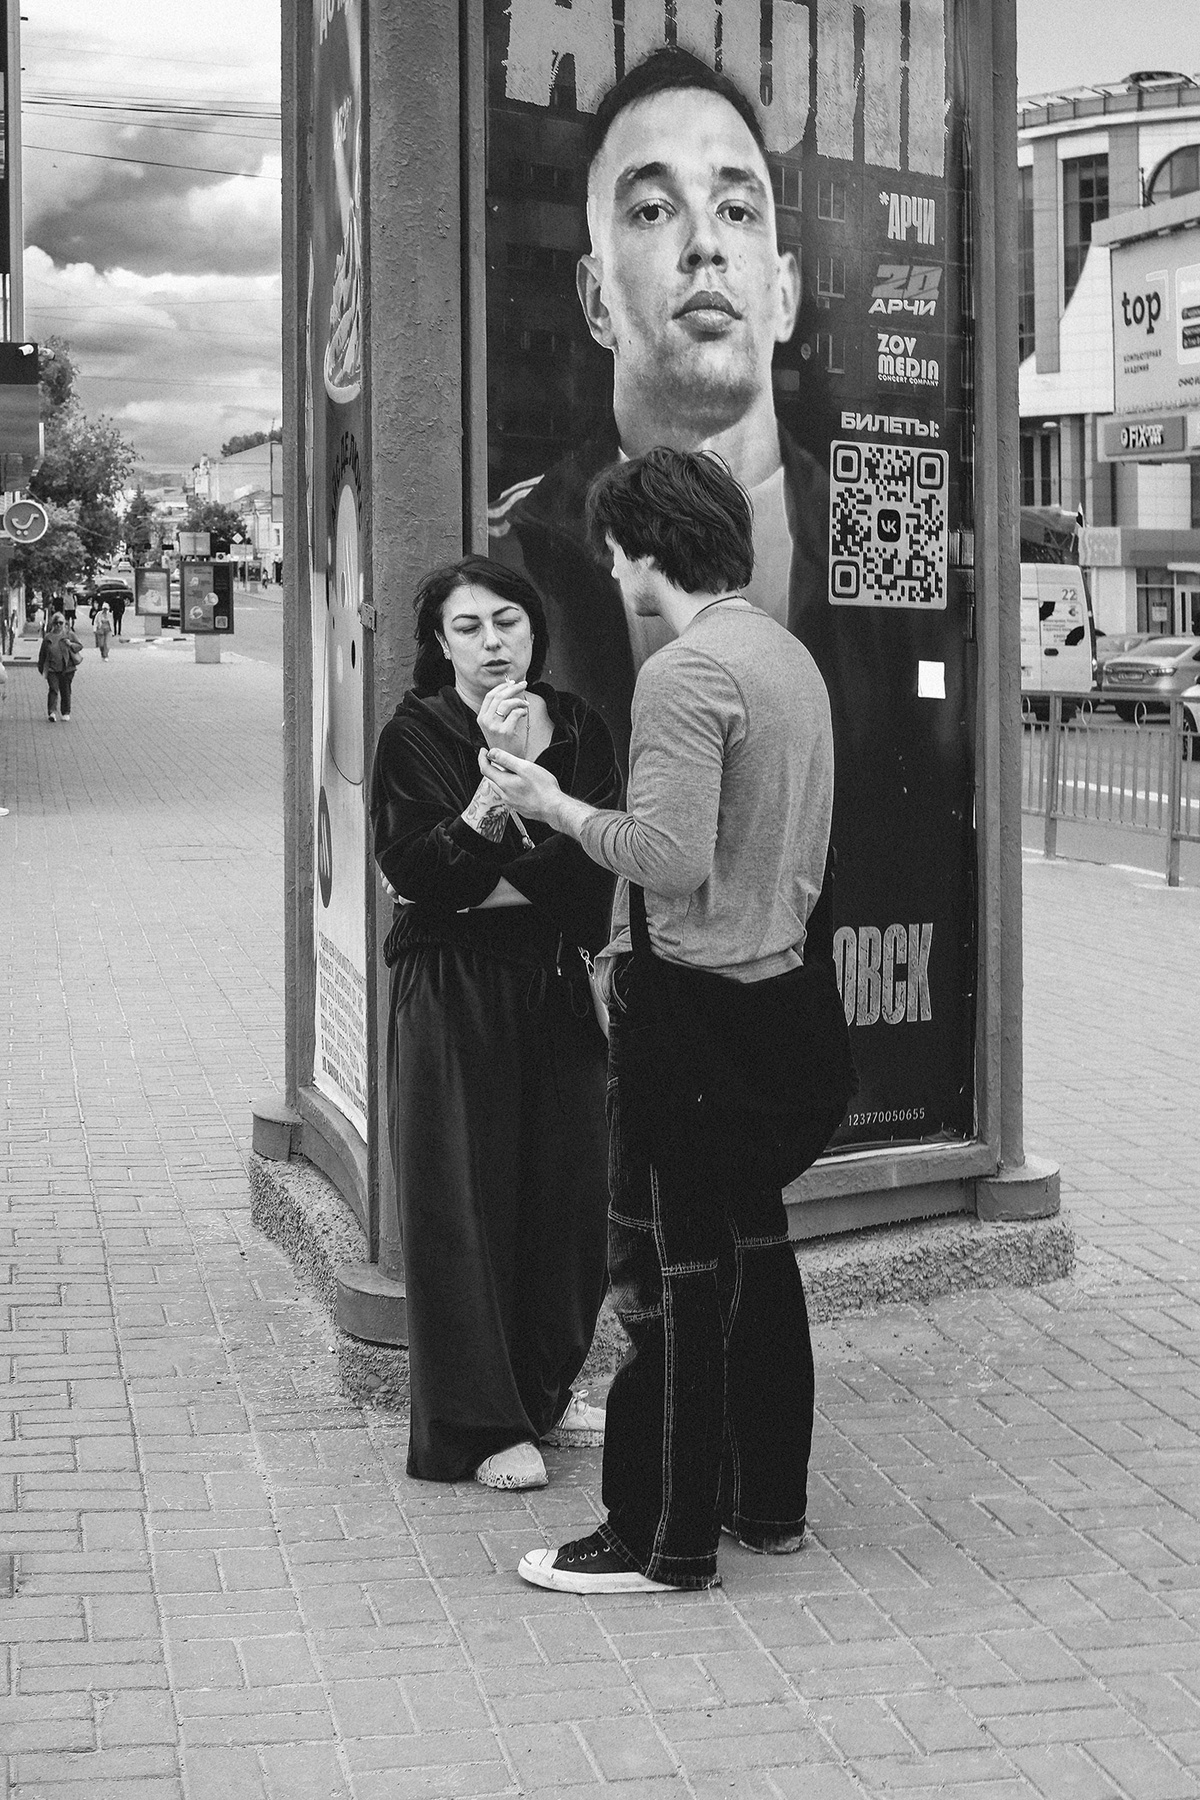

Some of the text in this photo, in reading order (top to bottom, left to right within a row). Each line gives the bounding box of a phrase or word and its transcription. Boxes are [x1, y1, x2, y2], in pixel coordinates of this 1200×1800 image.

[868, 298, 937, 316] АРЧИ
[1121, 291, 1161, 335] top
[877, 333, 917, 357] ZOV
[878, 354, 940, 380] MEDIA
[877, 373, 939, 387] CONCERT COMPANY
[841, 411, 940, 438] БИЛЕТЫ:
[880, 519, 898, 534] VK
[1061, 588, 1078, 601] 22
[848, 1107, 925, 1126] 123770050655
